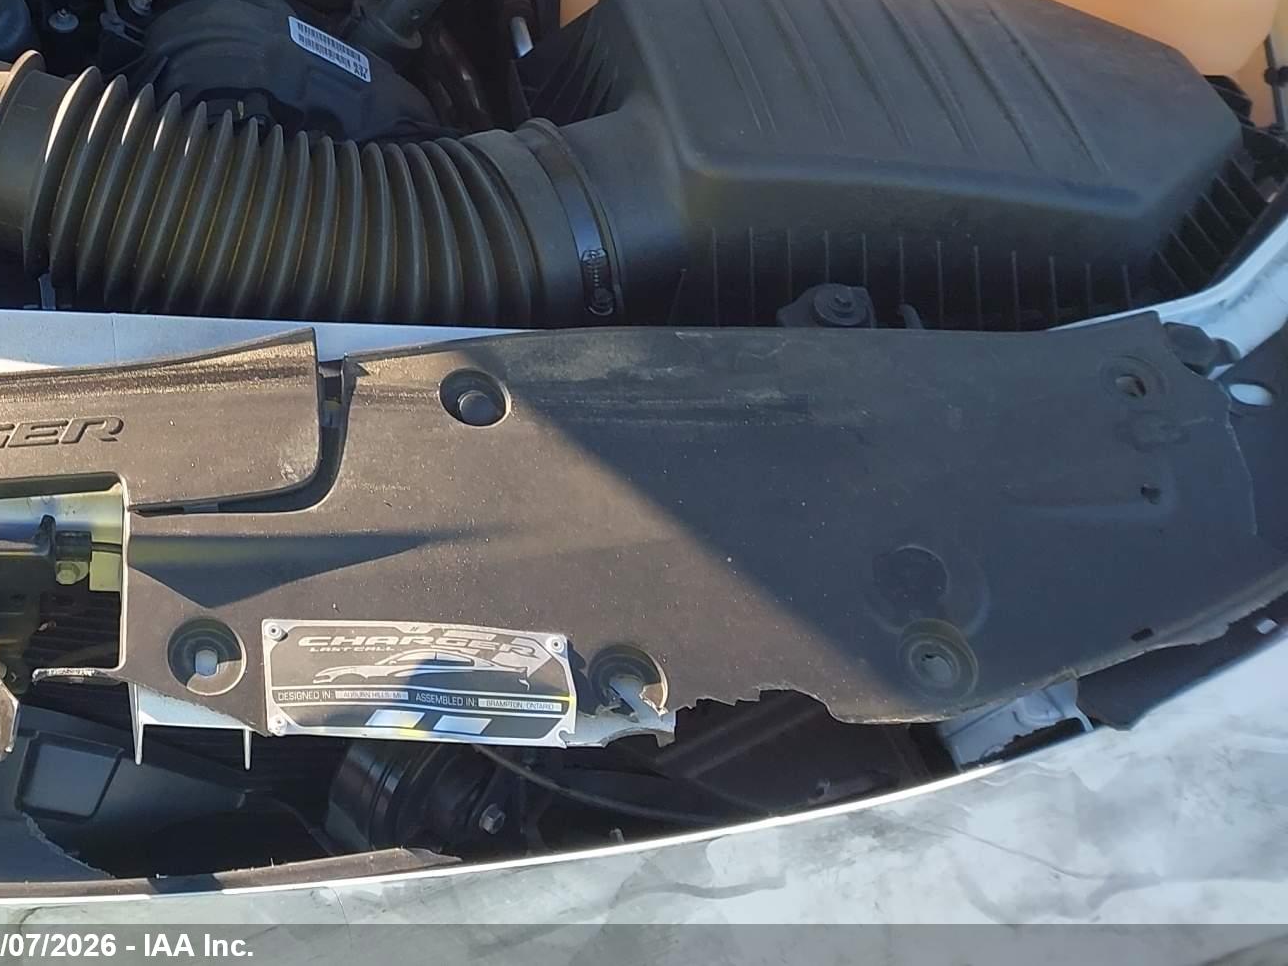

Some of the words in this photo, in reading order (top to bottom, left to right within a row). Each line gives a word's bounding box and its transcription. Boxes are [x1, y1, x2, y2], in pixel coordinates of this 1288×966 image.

[298, 635, 541, 660] CHARGER
[277, 690, 320, 701] DESIGNED
[415, 692, 463, 707] ASSEMBLED
[465, 697, 477, 707] IN:
